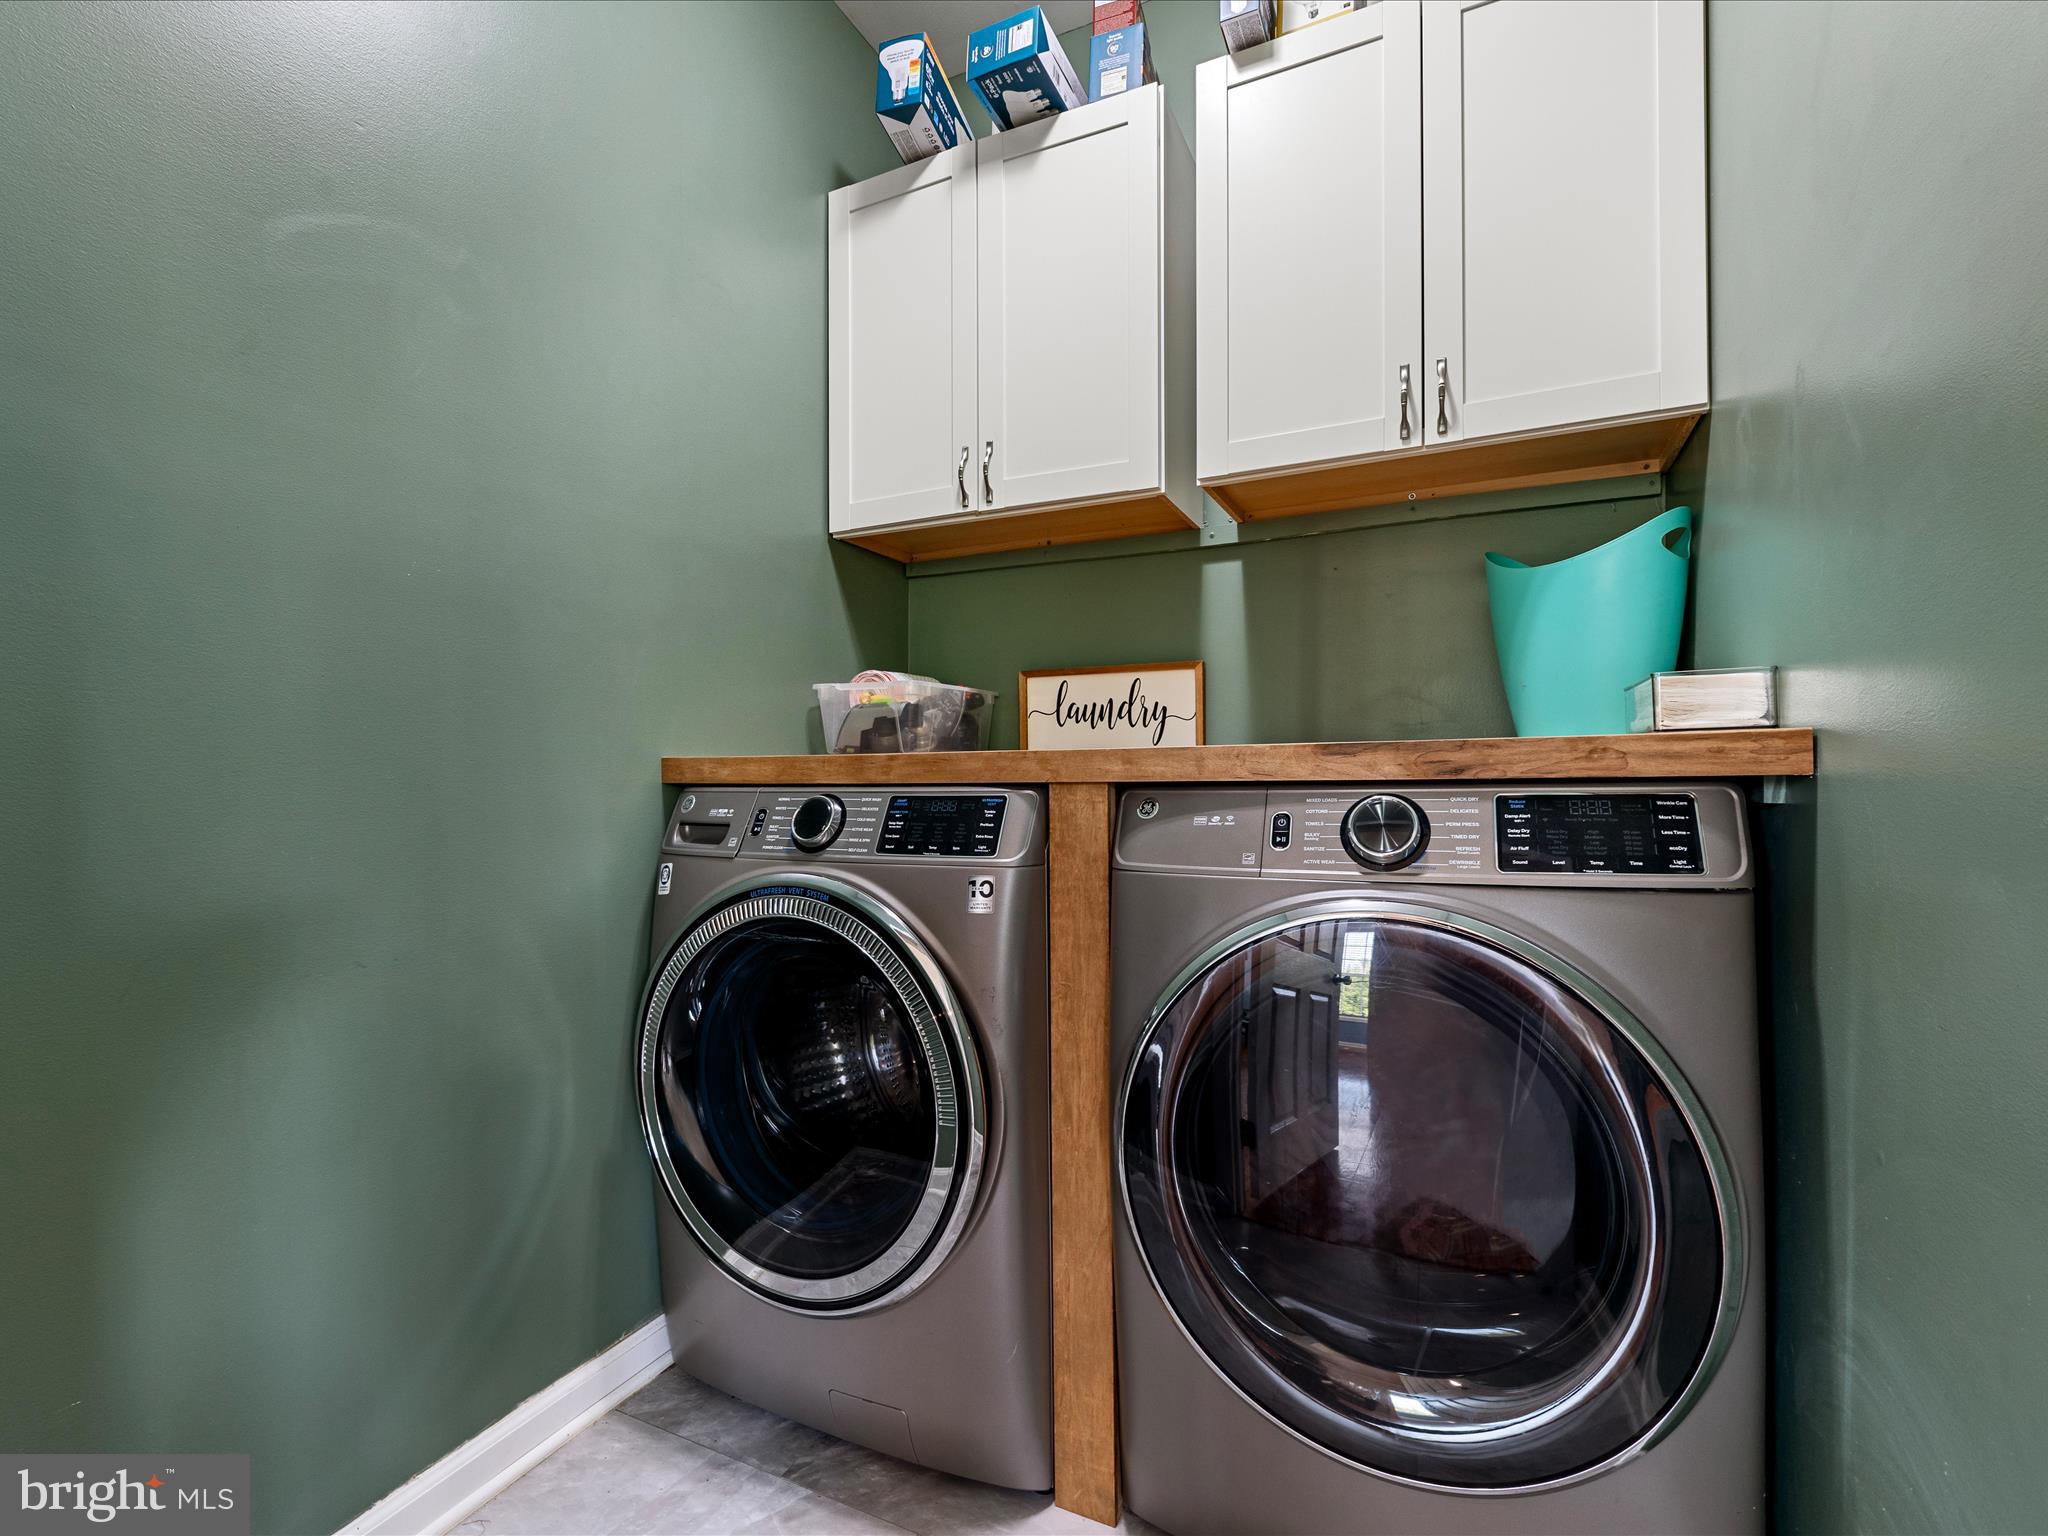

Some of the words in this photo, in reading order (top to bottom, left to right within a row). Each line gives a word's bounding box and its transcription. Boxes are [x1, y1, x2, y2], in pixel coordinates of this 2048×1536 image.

[1055, 677, 1168, 746] laundry
[750, 886, 786, 898] ULTRAFRESH
[788, 887, 804, 895] VENT
[806, 889, 830, 902] SYSTEM
[968, 880, 994, 898] 10
